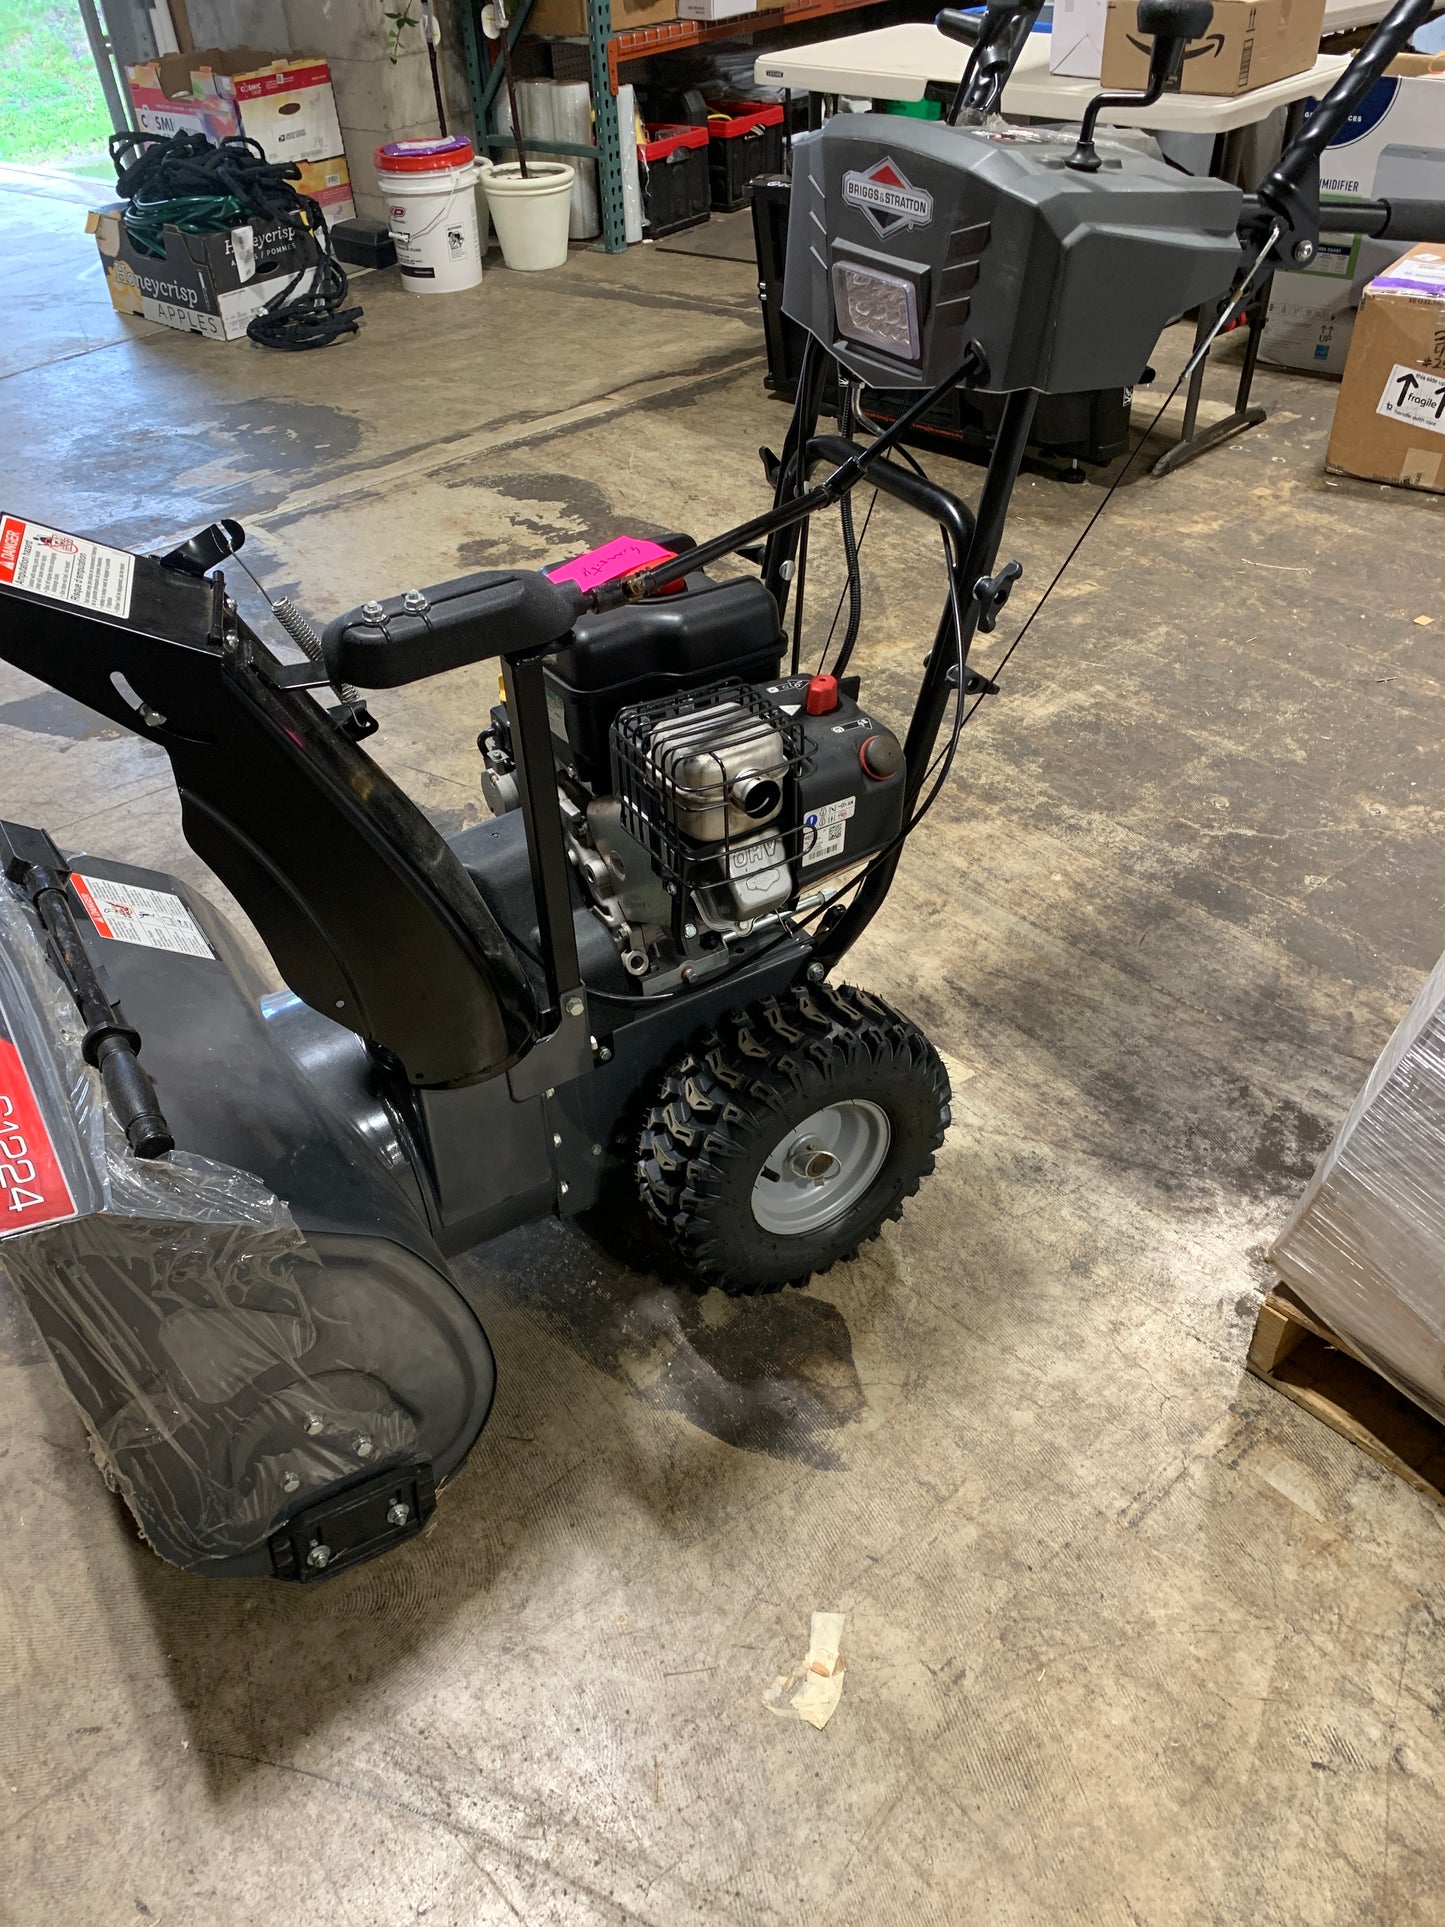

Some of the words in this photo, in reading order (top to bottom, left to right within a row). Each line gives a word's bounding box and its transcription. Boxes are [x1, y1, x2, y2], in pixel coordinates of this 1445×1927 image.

[848, 182, 879, 201] BRIGGS
[884, 193, 926, 214] STRATTON
[224, 226, 296, 255] Heycrisp
[266, 242, 297, 256] POMMES
[114, 260, 198, 308] Honeycrisp
[158, 304, 218, 334] APPLES
[1415, 373, 1426, 381] this
[1407, 392, 1437, 409] fragile
[1, 530, 20, 561] DANGER
[14, 555, 29, 585] Amputation
[22, 539, 32, 556] hazard
[70, 582, 82, 600] Risque
[733, 840, 776, 868] OHV
